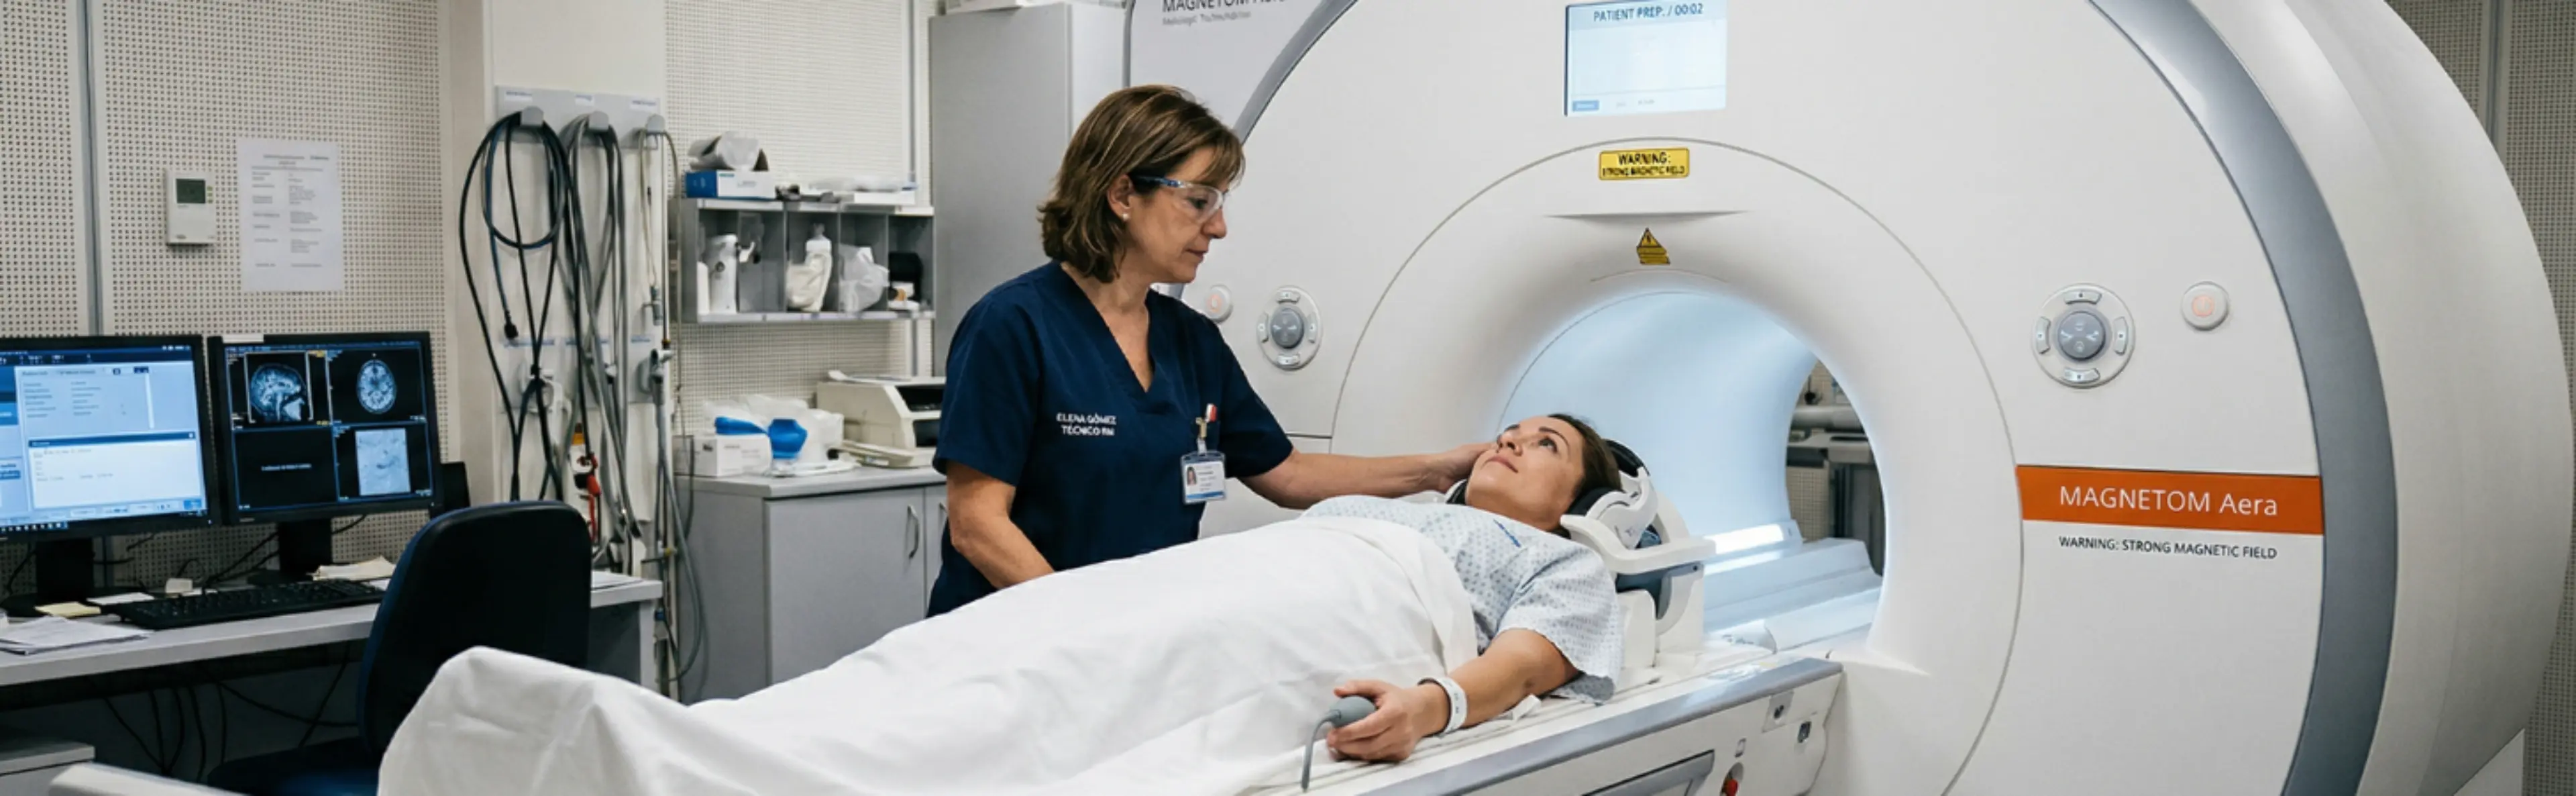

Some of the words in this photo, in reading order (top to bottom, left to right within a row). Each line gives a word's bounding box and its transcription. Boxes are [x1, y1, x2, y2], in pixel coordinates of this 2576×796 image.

[1594, 9, 1635, 21] PATIENT
[1637, 7, 1666, 18] PREP.
[1618, 152, 1671, 165] WARNING:
[2059, 486, 2210, 512] MAGNETOM
[2219, 493, 2278, 515] Aera
[2059, 536, 2119, 550] WARNING:
[2123, 541, 2171, 554] STRONG
[2174, 543, 2239, 558] MAGNETIC
[2243, 546, 2277, 559] FIELD
